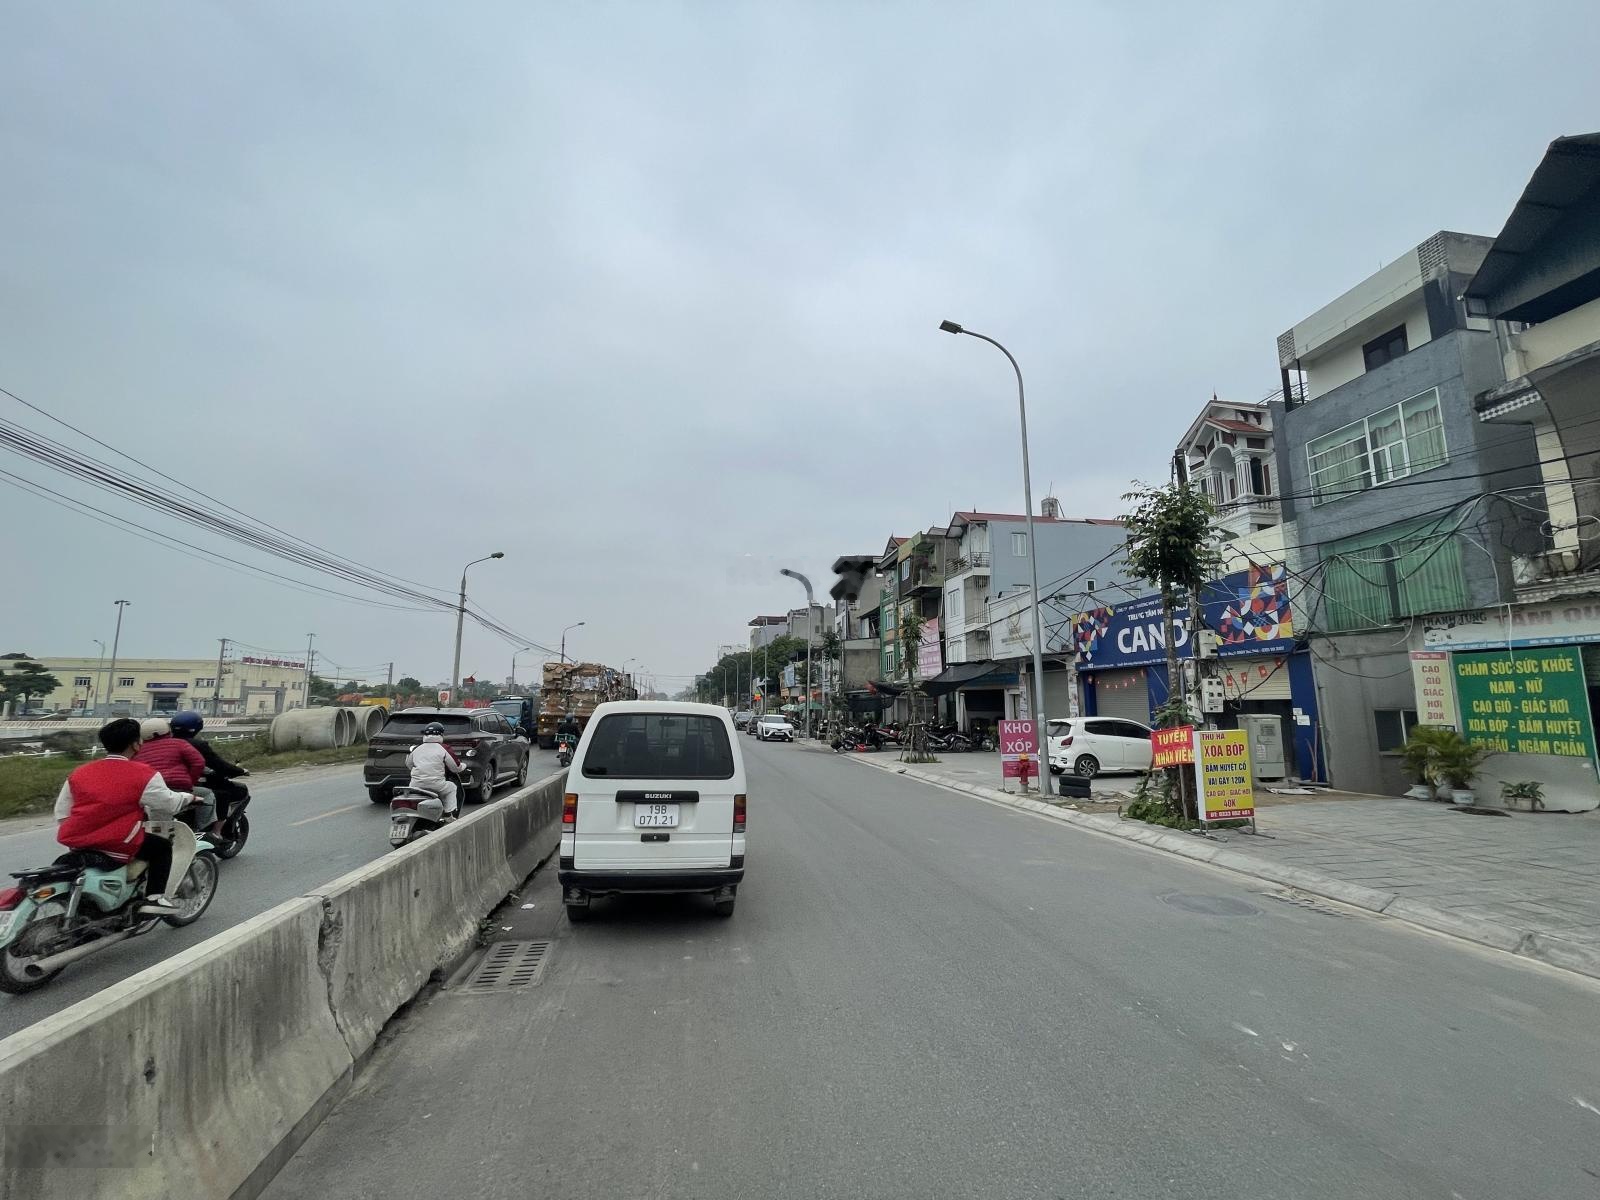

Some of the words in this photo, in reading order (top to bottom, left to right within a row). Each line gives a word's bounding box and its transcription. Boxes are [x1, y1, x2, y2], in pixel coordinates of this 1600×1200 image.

[1489, 681, 1515, 694] NAM
[1525, 677, 1543, 693] NỮ
[1472, 700, 1492, 716] CẠO
[1004, 722, 1031, 734] KHO
[1202, 733, 1213, 741] THU
[1006, 738, 1032, 753] XỐP
[1226, 741, 1245, 756] BÓP
[649, 804, 667, 815] 19B
[1223, 799, 1236, 808] 40K
[639, 815, 673, 825] 071.21
